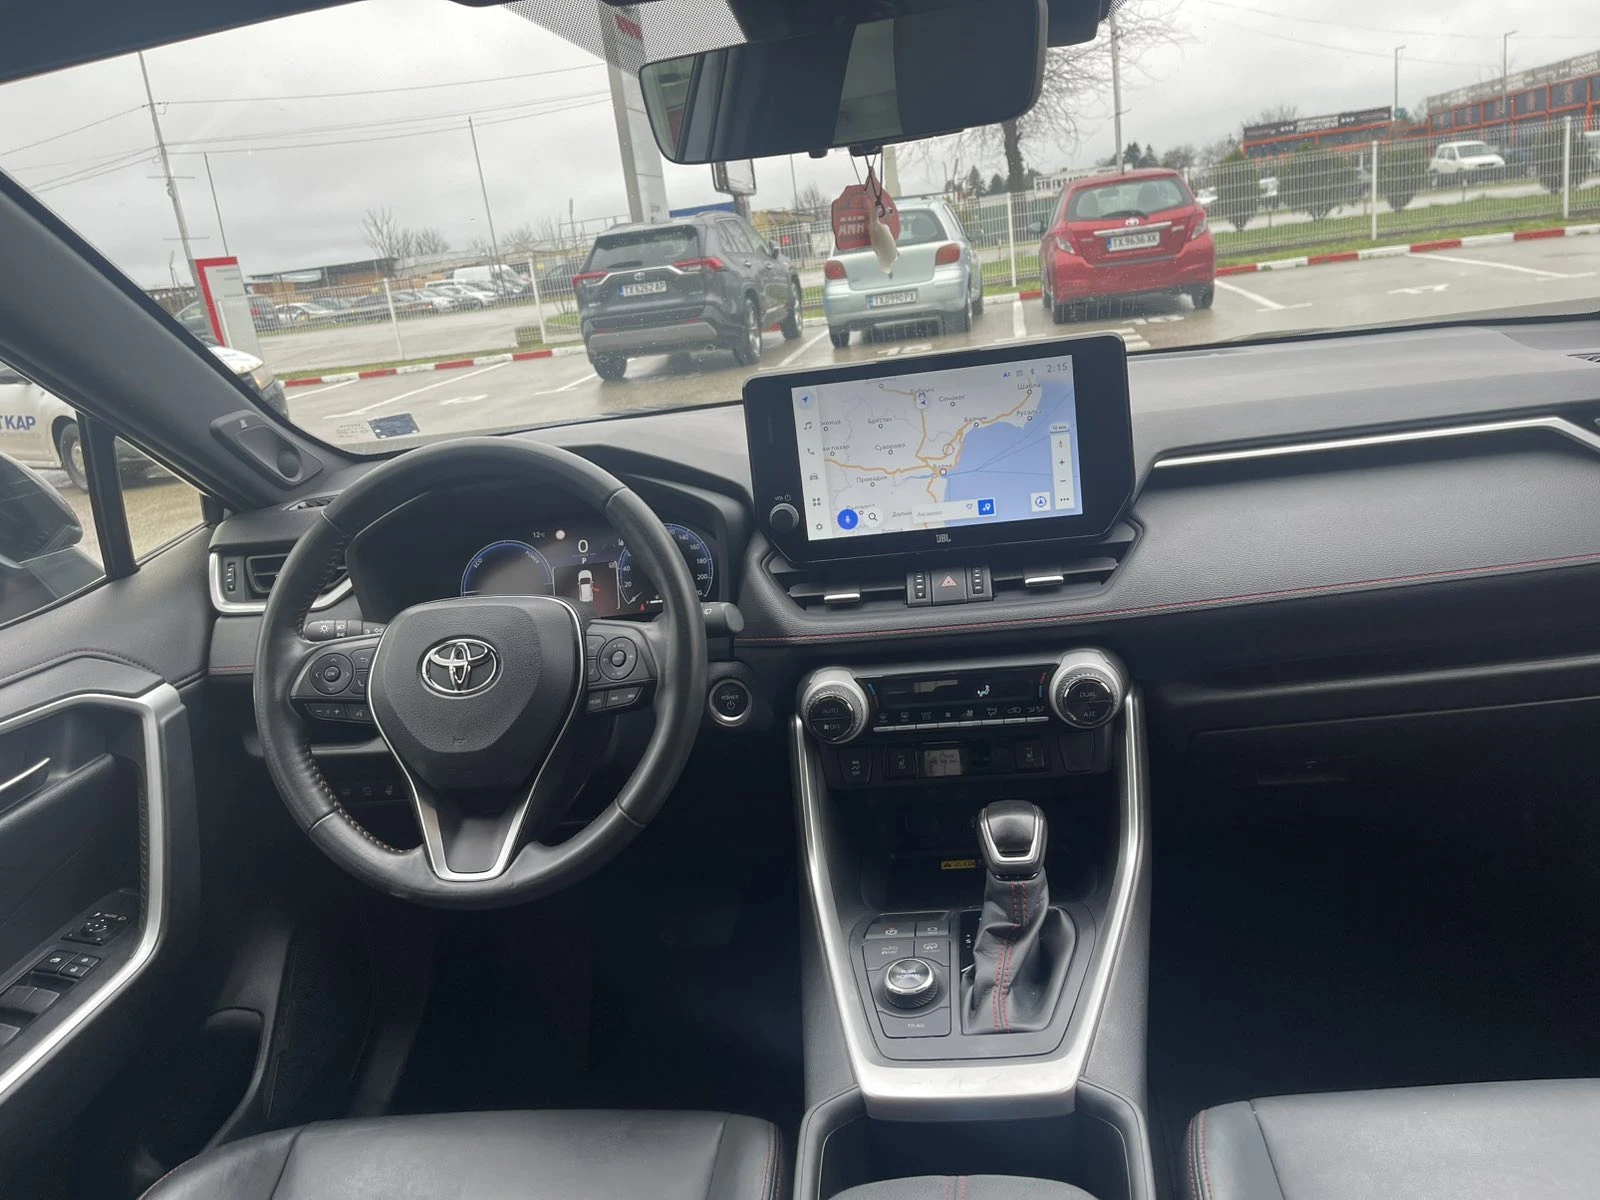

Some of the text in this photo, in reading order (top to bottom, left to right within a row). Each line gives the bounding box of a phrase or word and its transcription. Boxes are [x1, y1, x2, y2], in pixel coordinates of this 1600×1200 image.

[1047, 362, 1068, 373] 2:15
[936, 534, 951, 543] JBL
[578, 539, 589, 553] 0
